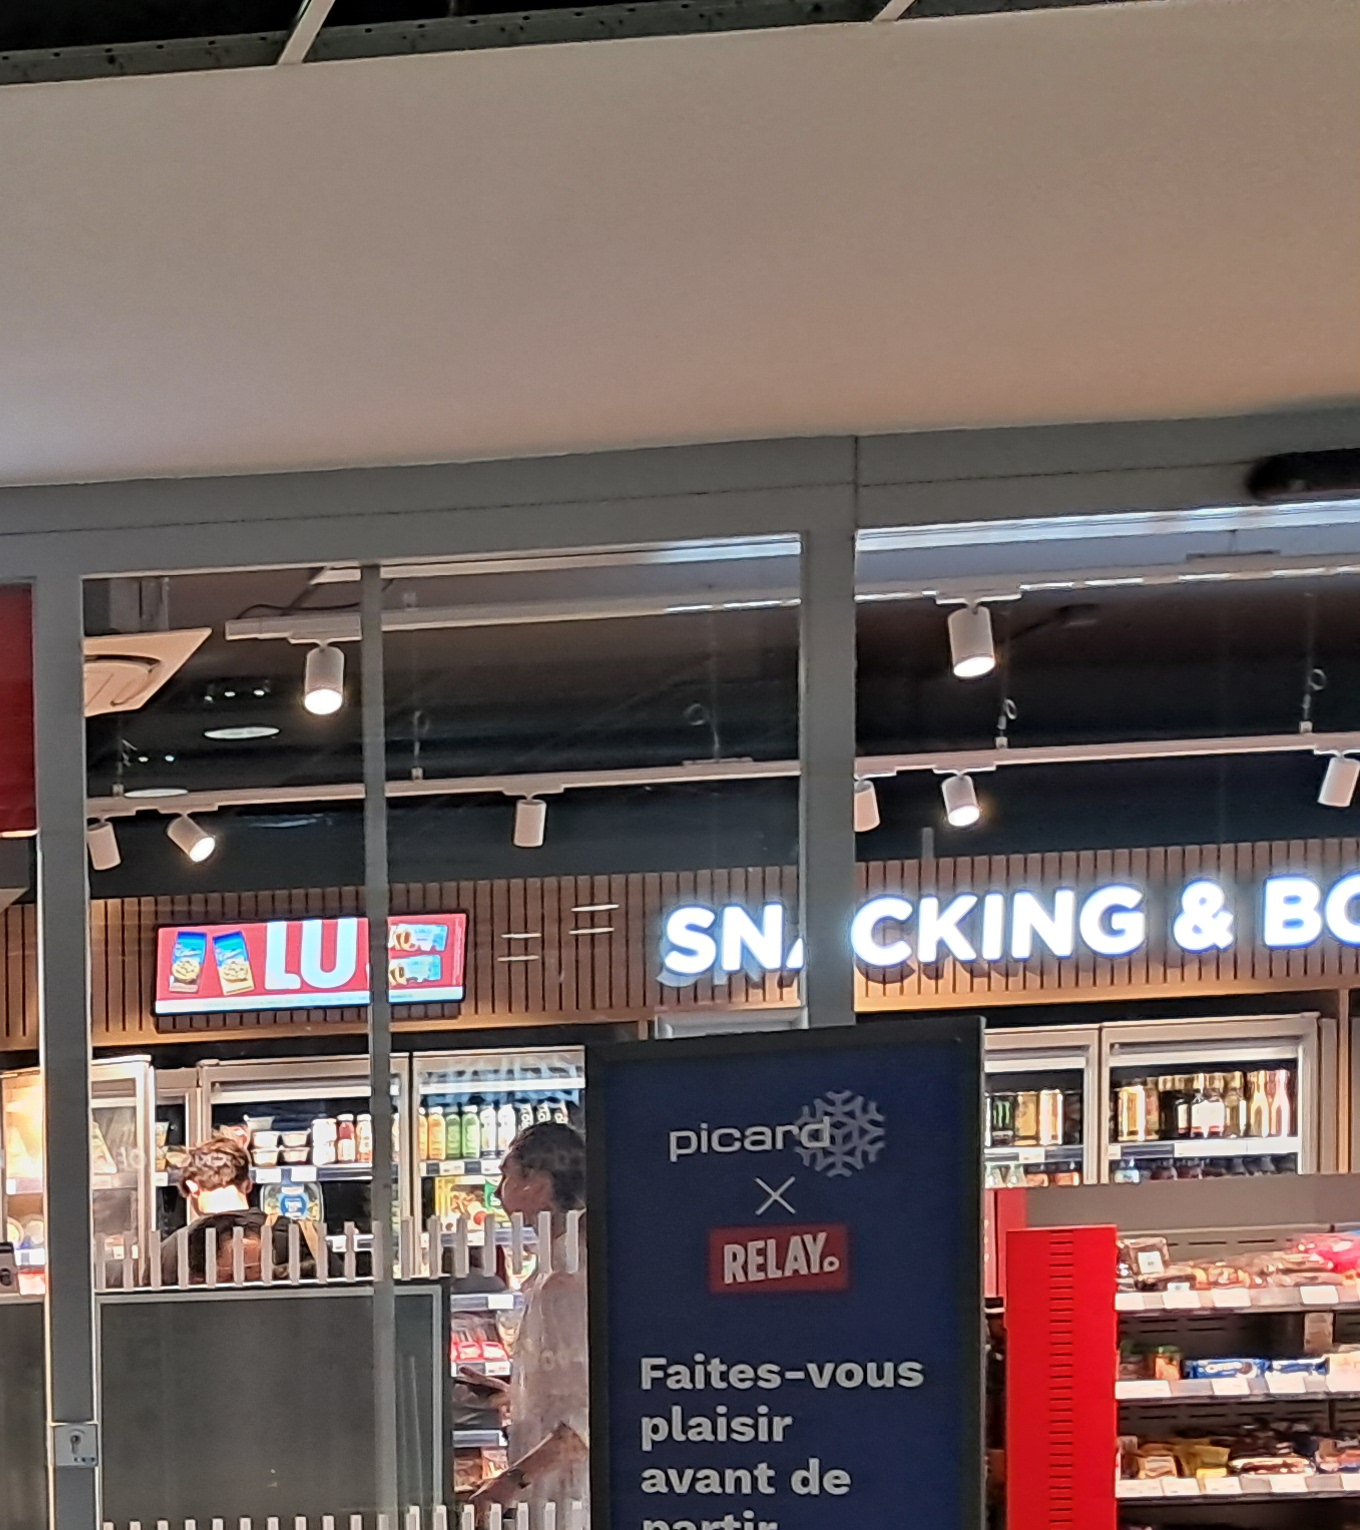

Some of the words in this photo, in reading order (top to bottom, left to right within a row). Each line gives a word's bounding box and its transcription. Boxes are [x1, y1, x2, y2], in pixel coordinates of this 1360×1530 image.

[664, 885, 1146, 976] SNCKING
[1174, 880, 1235, 953] &
[265, 917, 358, 991] LU
[669, 1116, 834, 1162] picard
[640, 1354, 925, 1391] Faites-vous
[641, 1404, 793, 1451] plaisir
[641, 1464, 776, 1496] avant
[790, 1457, 853, 1497] de
